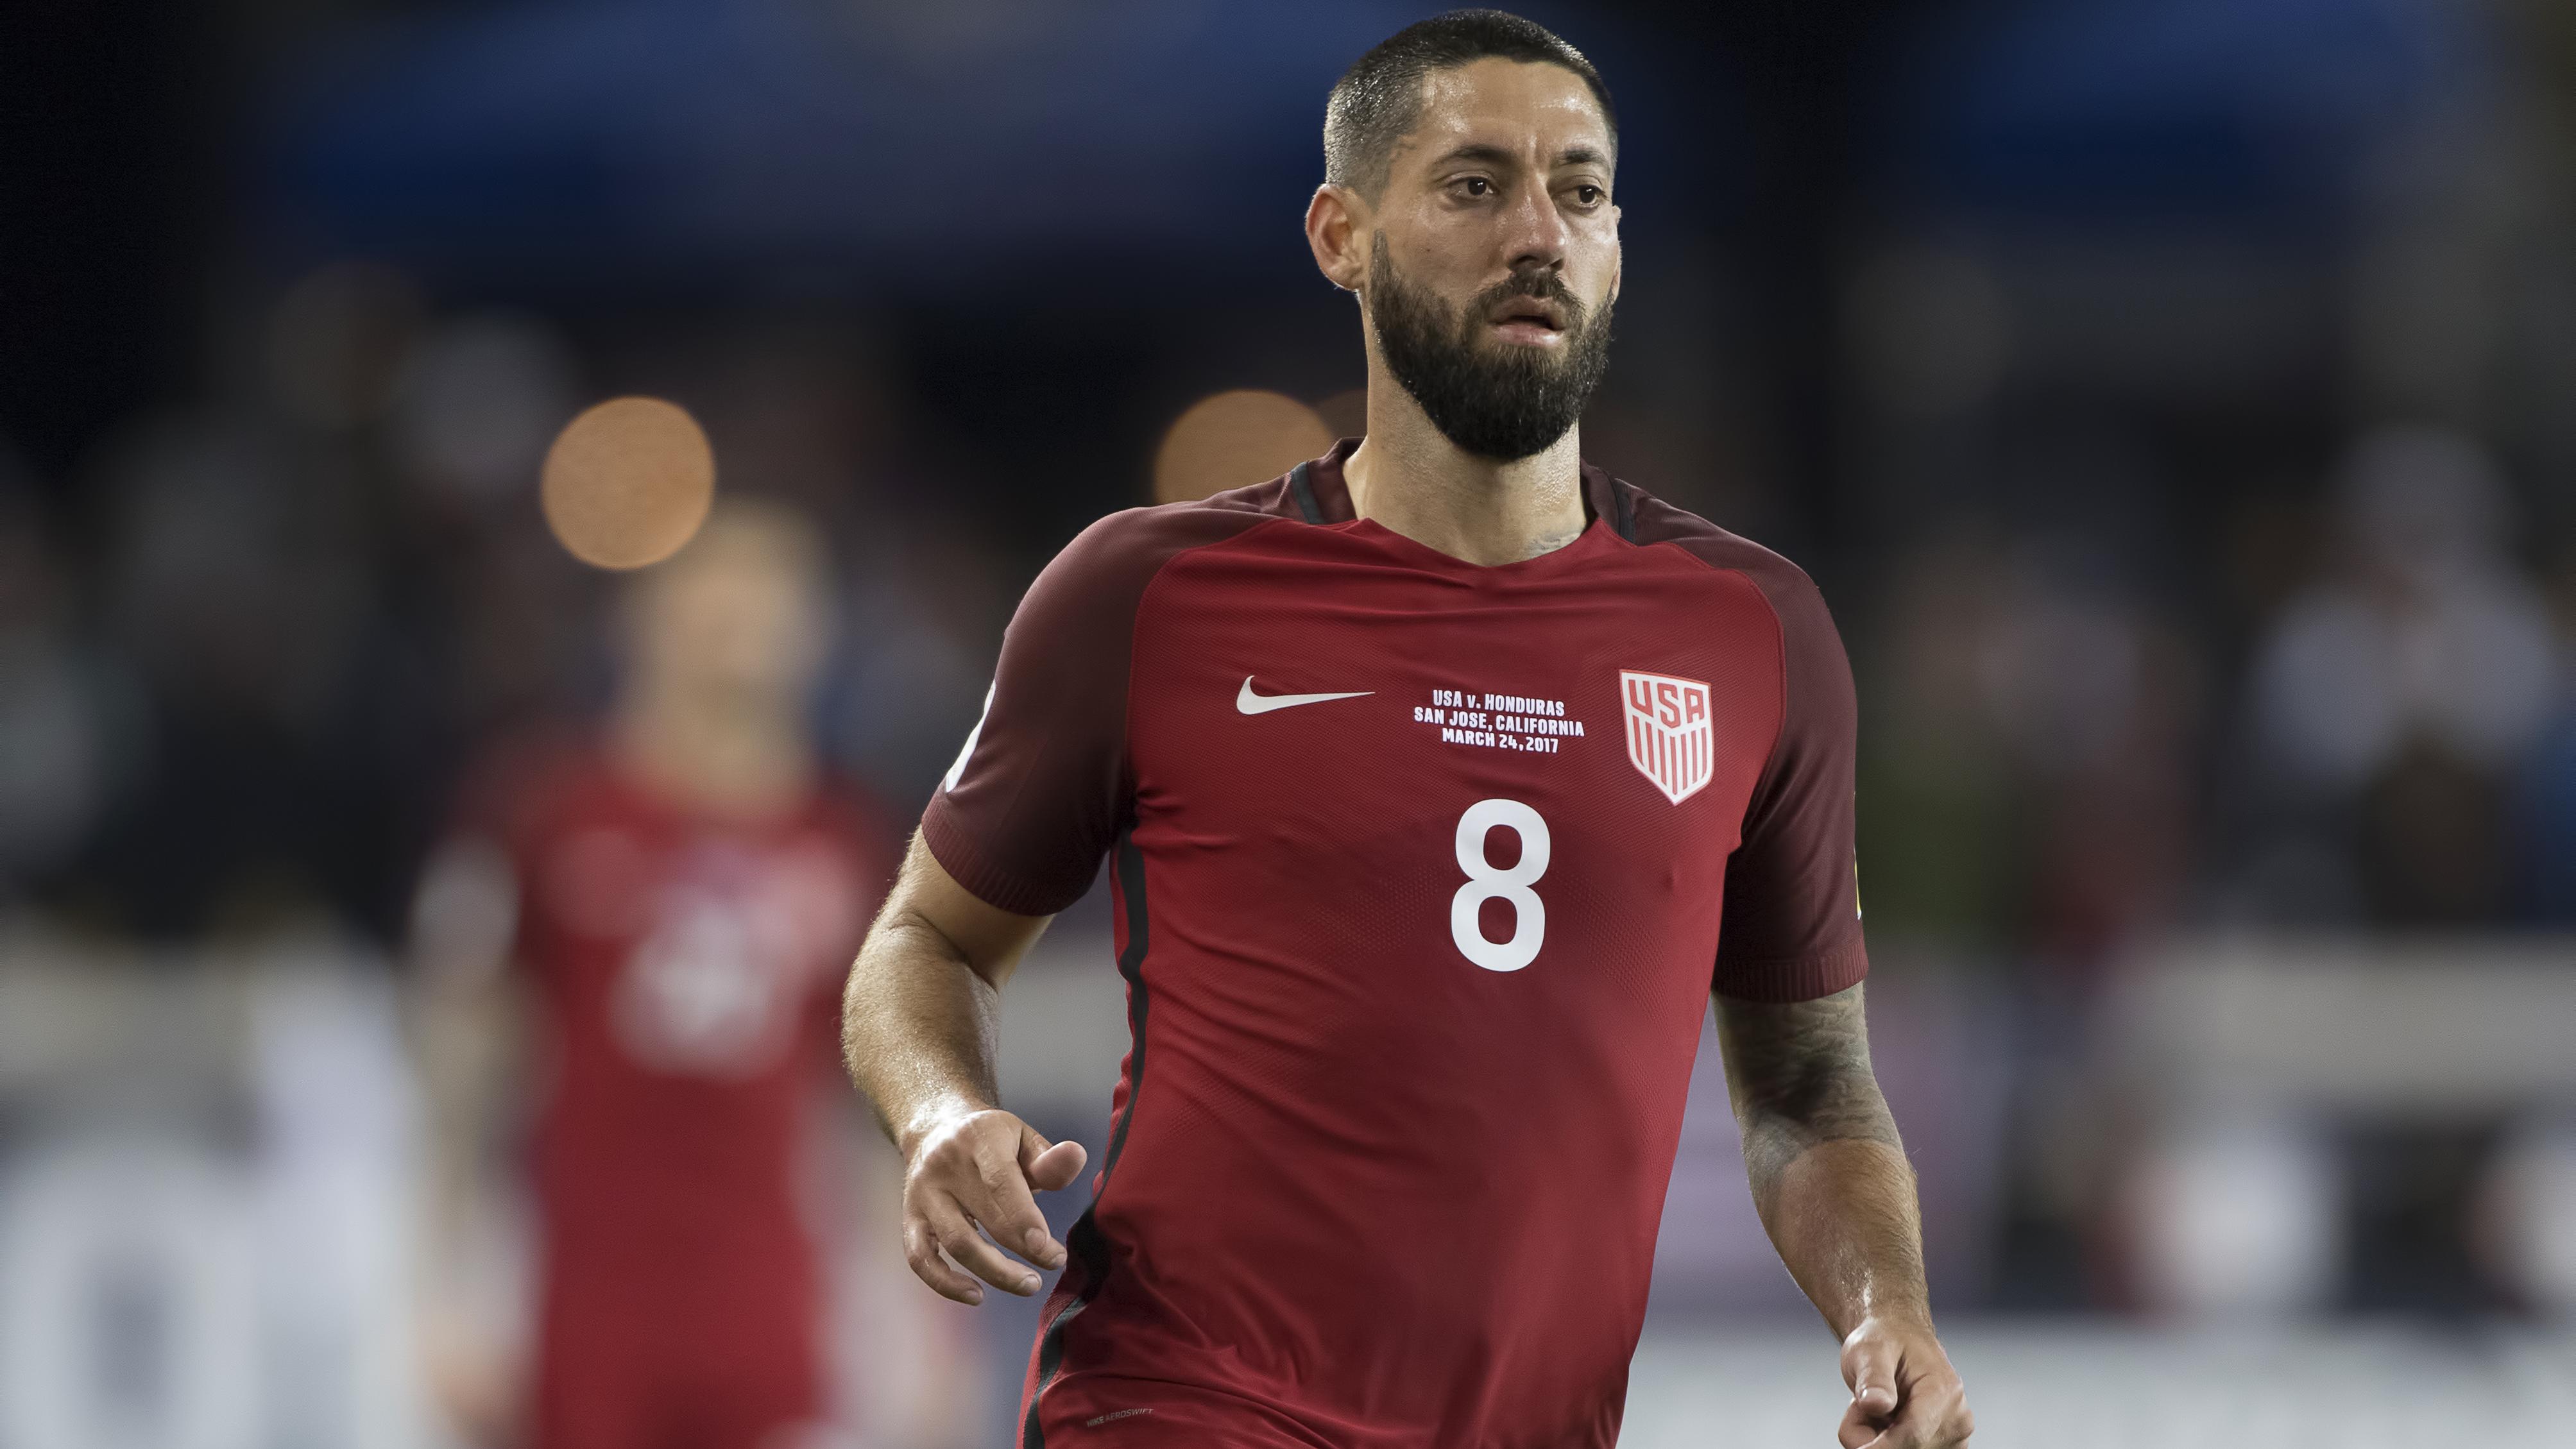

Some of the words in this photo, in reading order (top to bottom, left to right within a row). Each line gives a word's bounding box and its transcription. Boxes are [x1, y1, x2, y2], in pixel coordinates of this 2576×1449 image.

[1433, 690, 1462, 708] USA
[1467, 695, 1481, 709] v.
[1485, 693, 1565, 716] HONDURAS
[1628, 679, 1705, 728] USA
[1414, 707, 1444, 724] SAN
[1449, 711, 1493, 732] JOSE,
[1496, 715, 1585, 736] CALIFORNIA
[1442, 727, 1496, 747] MARCH
[1451, 798, 1551, 972] 8
[1087, 1416, 1104, 1427] NIKE
